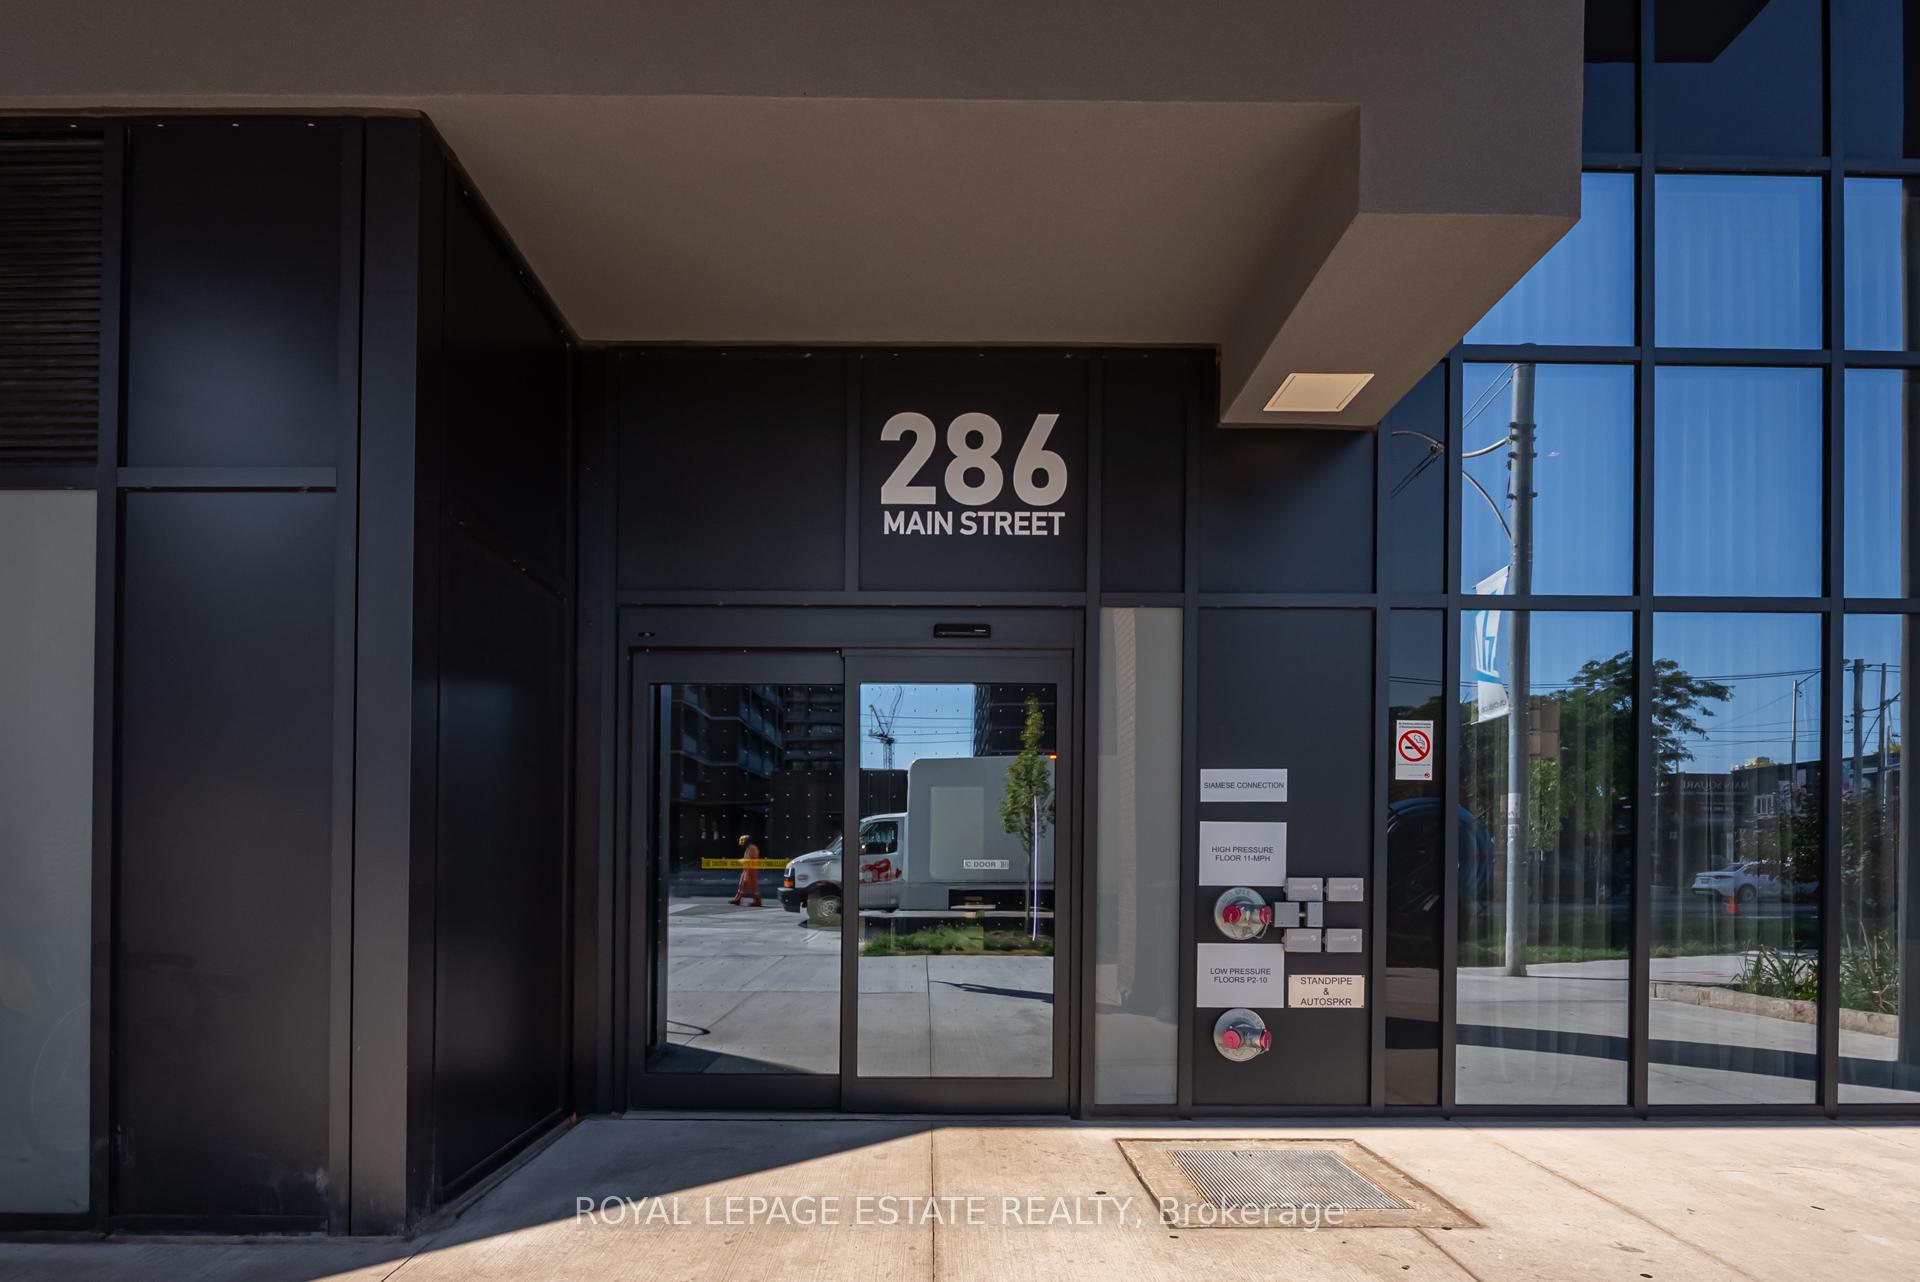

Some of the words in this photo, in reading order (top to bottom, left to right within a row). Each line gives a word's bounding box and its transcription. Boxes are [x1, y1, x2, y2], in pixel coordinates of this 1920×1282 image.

[880, 411, 1068, 507] 286
[883, 510, 953, 535] MAIN
[959, 511, 1066, 536] STREET
[1203, 781, 1235, 789] SIAMESE
[1236, 781, 1285, 789] CONNECTION
[1232, 846, 1274, 854] PRESSURE
[1210, 967, 1228, 975] LOW
[1213, 976, 1246, 984] FLOORS
[1246, 976, 1268, 984] P2-10
[1300, 976, 1353, 986] STANDPIPE
[1322, 987, 1330, 996] &
[1300, 997, 1352, 1006] AUTOSPKR
